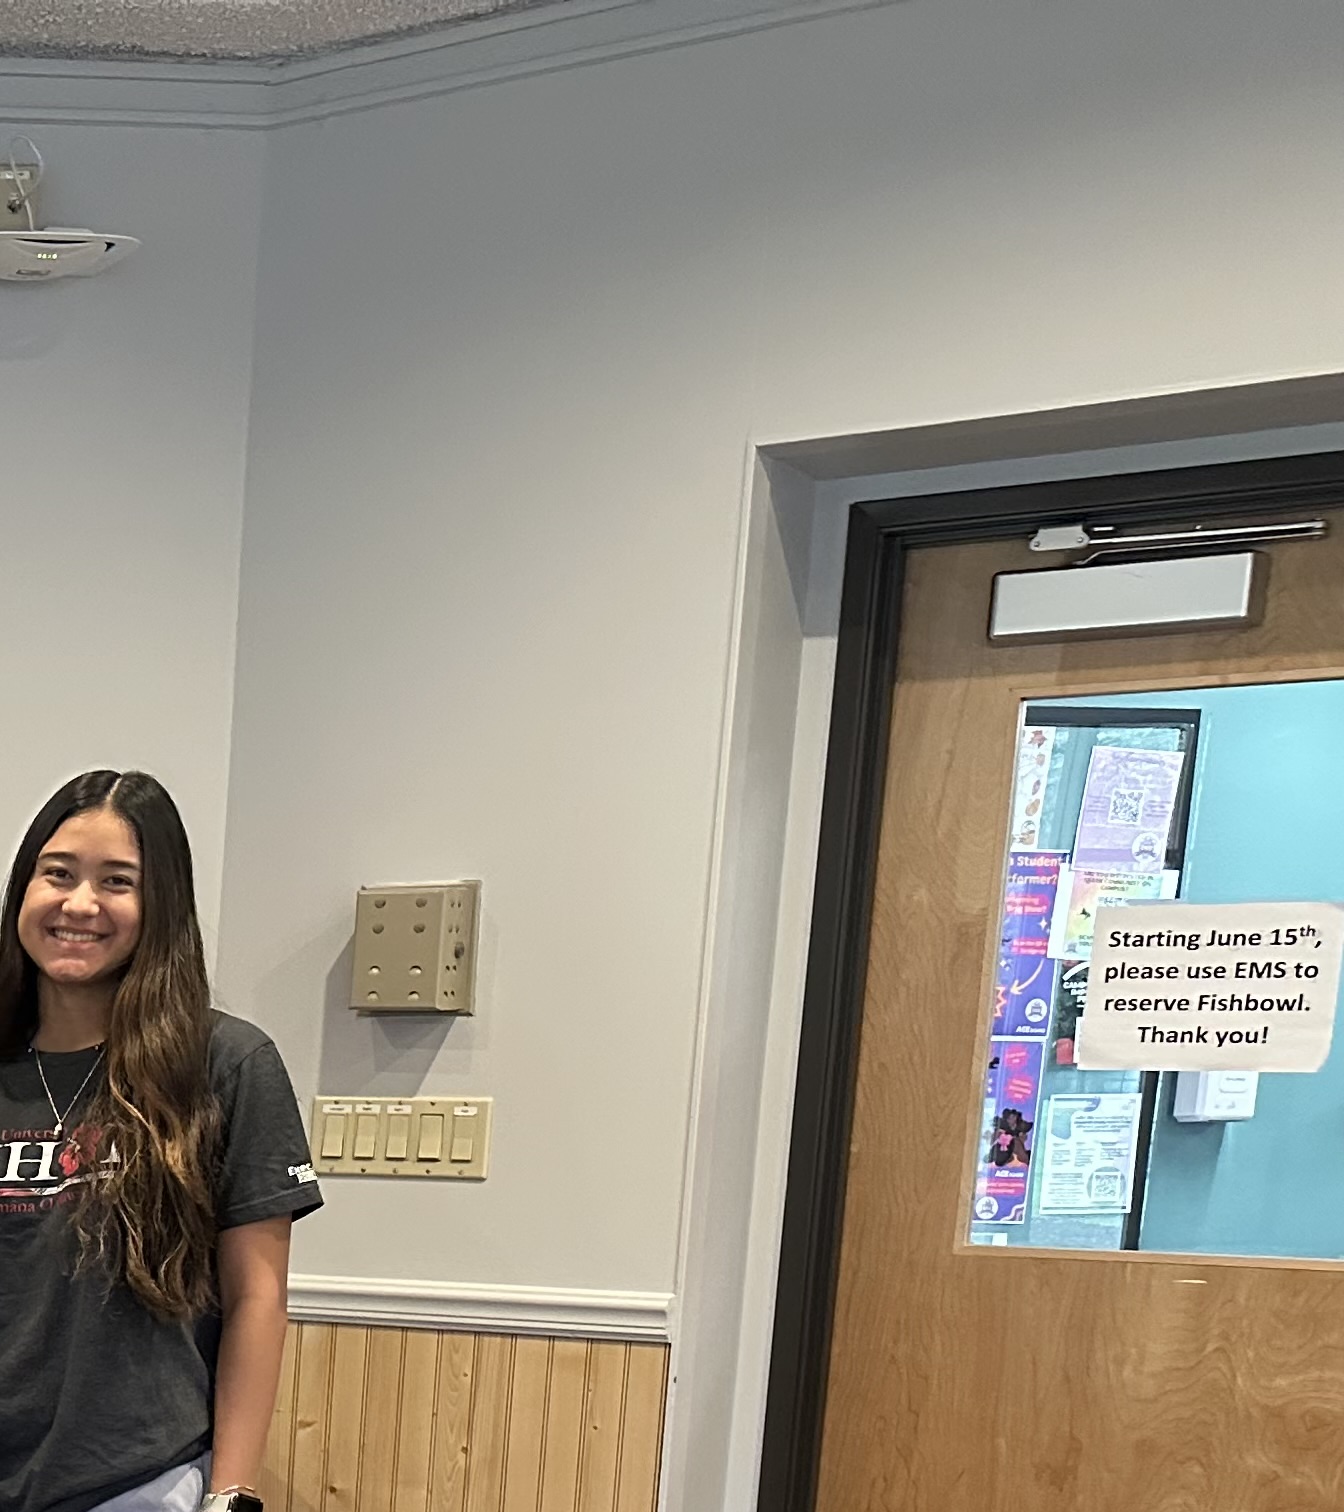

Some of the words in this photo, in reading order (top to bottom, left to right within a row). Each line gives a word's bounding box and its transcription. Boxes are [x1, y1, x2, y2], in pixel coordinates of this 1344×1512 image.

[1109, 931, 1200, 950] Starting
[1207, 930, 1261, 947] June
[1105, 962, 1179, 983] please
[1187, 966, 1226, 979] use
[1235, 962, 1286, 979] EMS
[1294, 963, 1318, 979] to
[1104, 997, 1190, 1011] reserve
[1198, 994, 1310, 1011] Fishbowl.
[1138, 1026, 1208, 1043] Thank
[1216, 1027, 1268, 1047] you!
